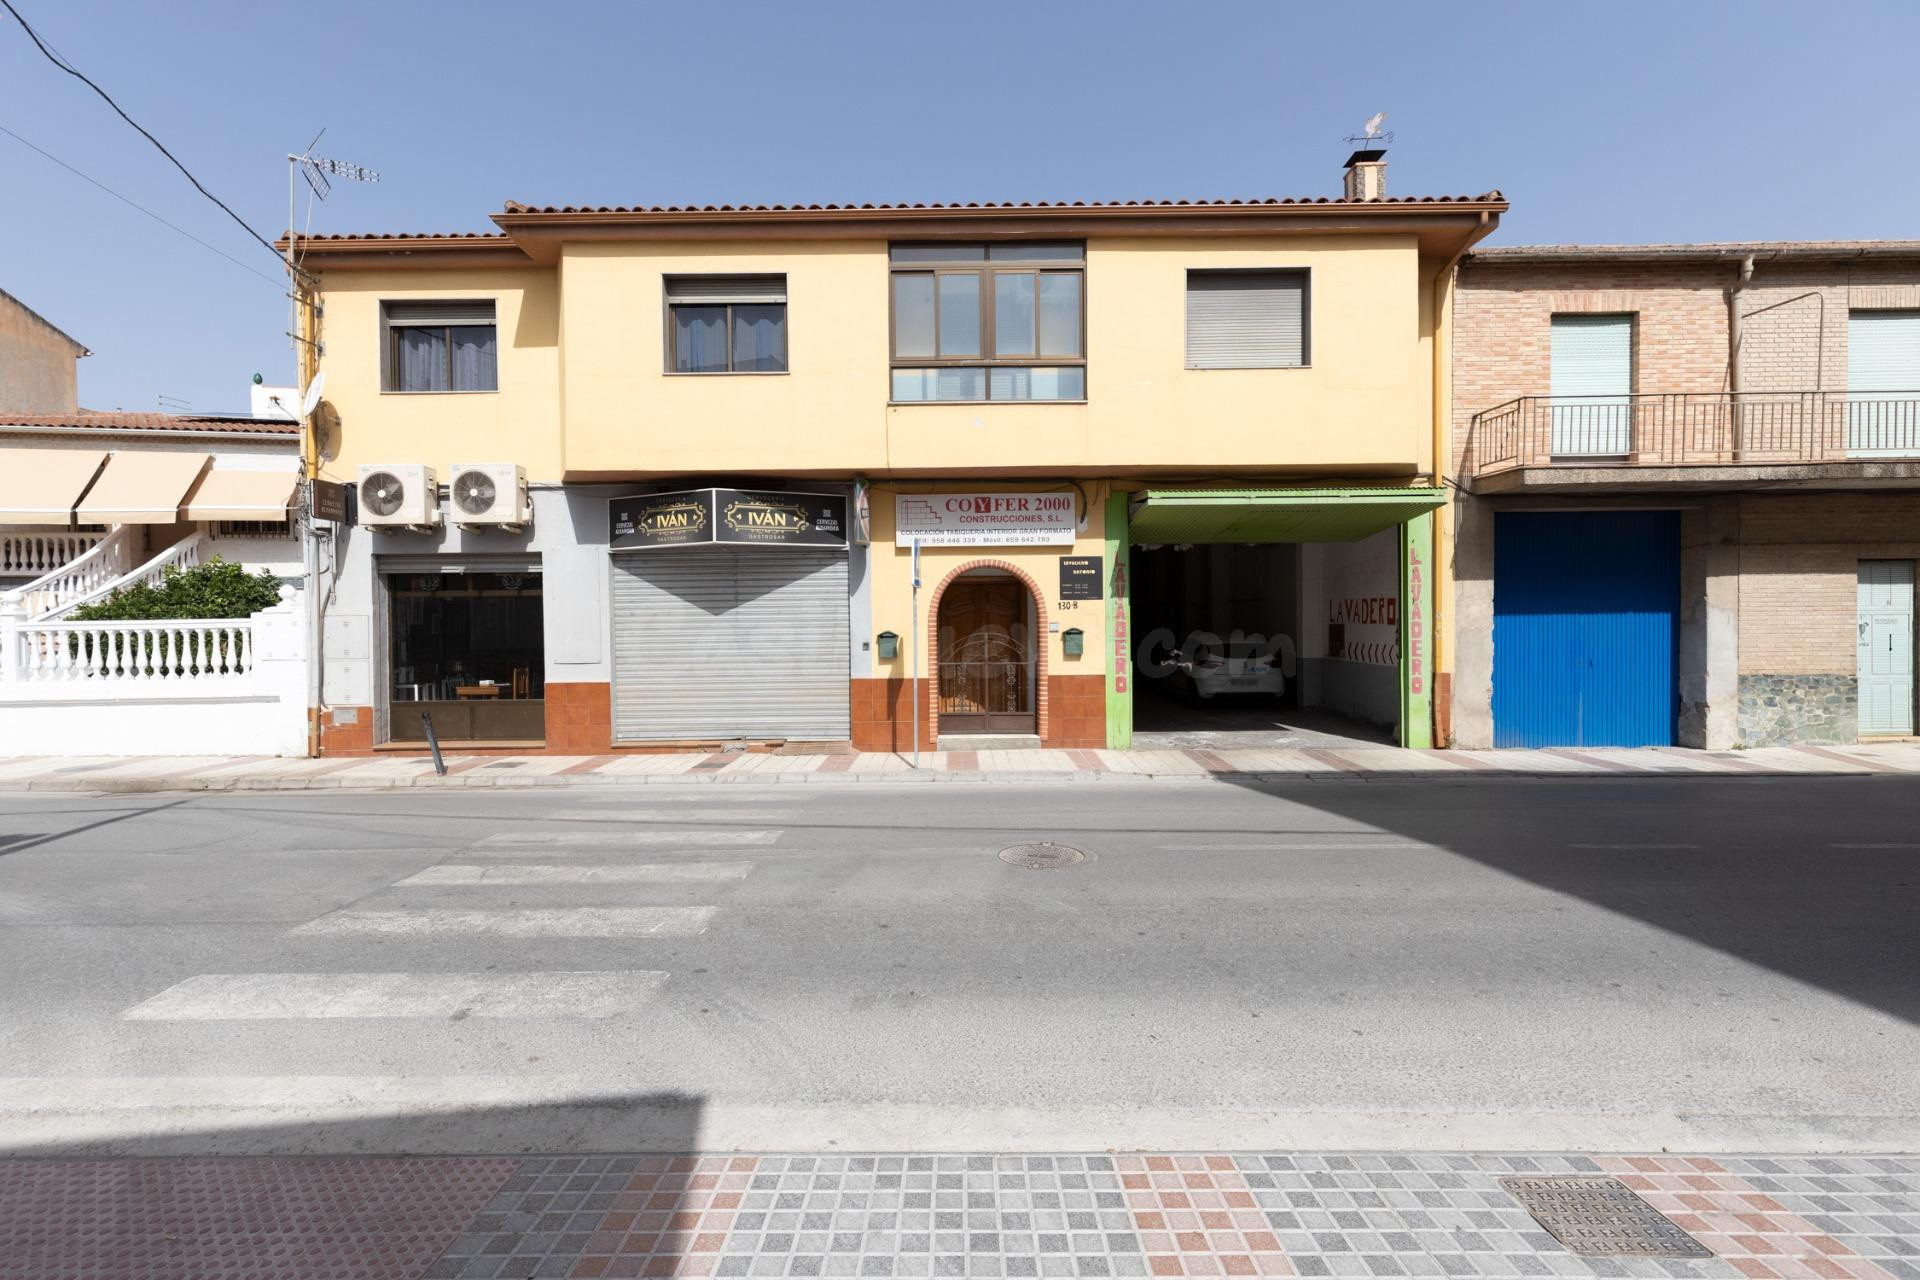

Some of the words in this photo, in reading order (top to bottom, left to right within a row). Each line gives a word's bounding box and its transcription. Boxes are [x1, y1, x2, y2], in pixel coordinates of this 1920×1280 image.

[1035, 496, 1071, 512] 2000
[656, 510, 687, 528] IVÁN
[748, 509, 786, 526] IVÁN
[959, 514, 1046, 524] CONSTRUCCIONES,
[1047, 514, 1063, 522] S.L.
[1329, 598, 1396, 625] LAVADERO
[1410, 548, 1422, 694] LAVADERO
